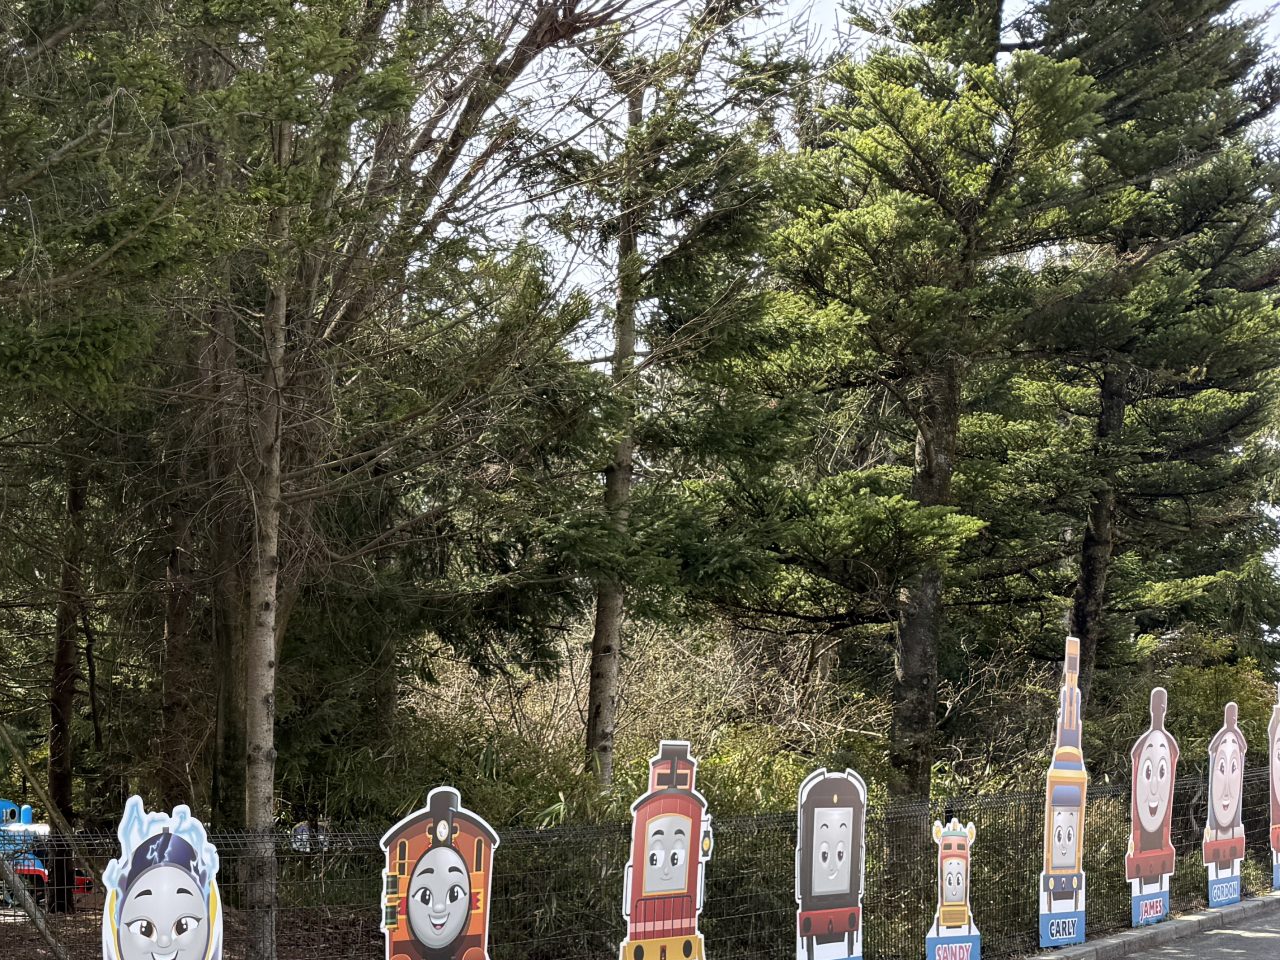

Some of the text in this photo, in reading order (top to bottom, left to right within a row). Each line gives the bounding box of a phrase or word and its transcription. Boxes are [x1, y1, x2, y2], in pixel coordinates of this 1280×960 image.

[1213, 881, 1237, 901] GORDON
[1140, 898, 1163, 923] JAMES
[1049, 918, 1078, 939] CARLY
